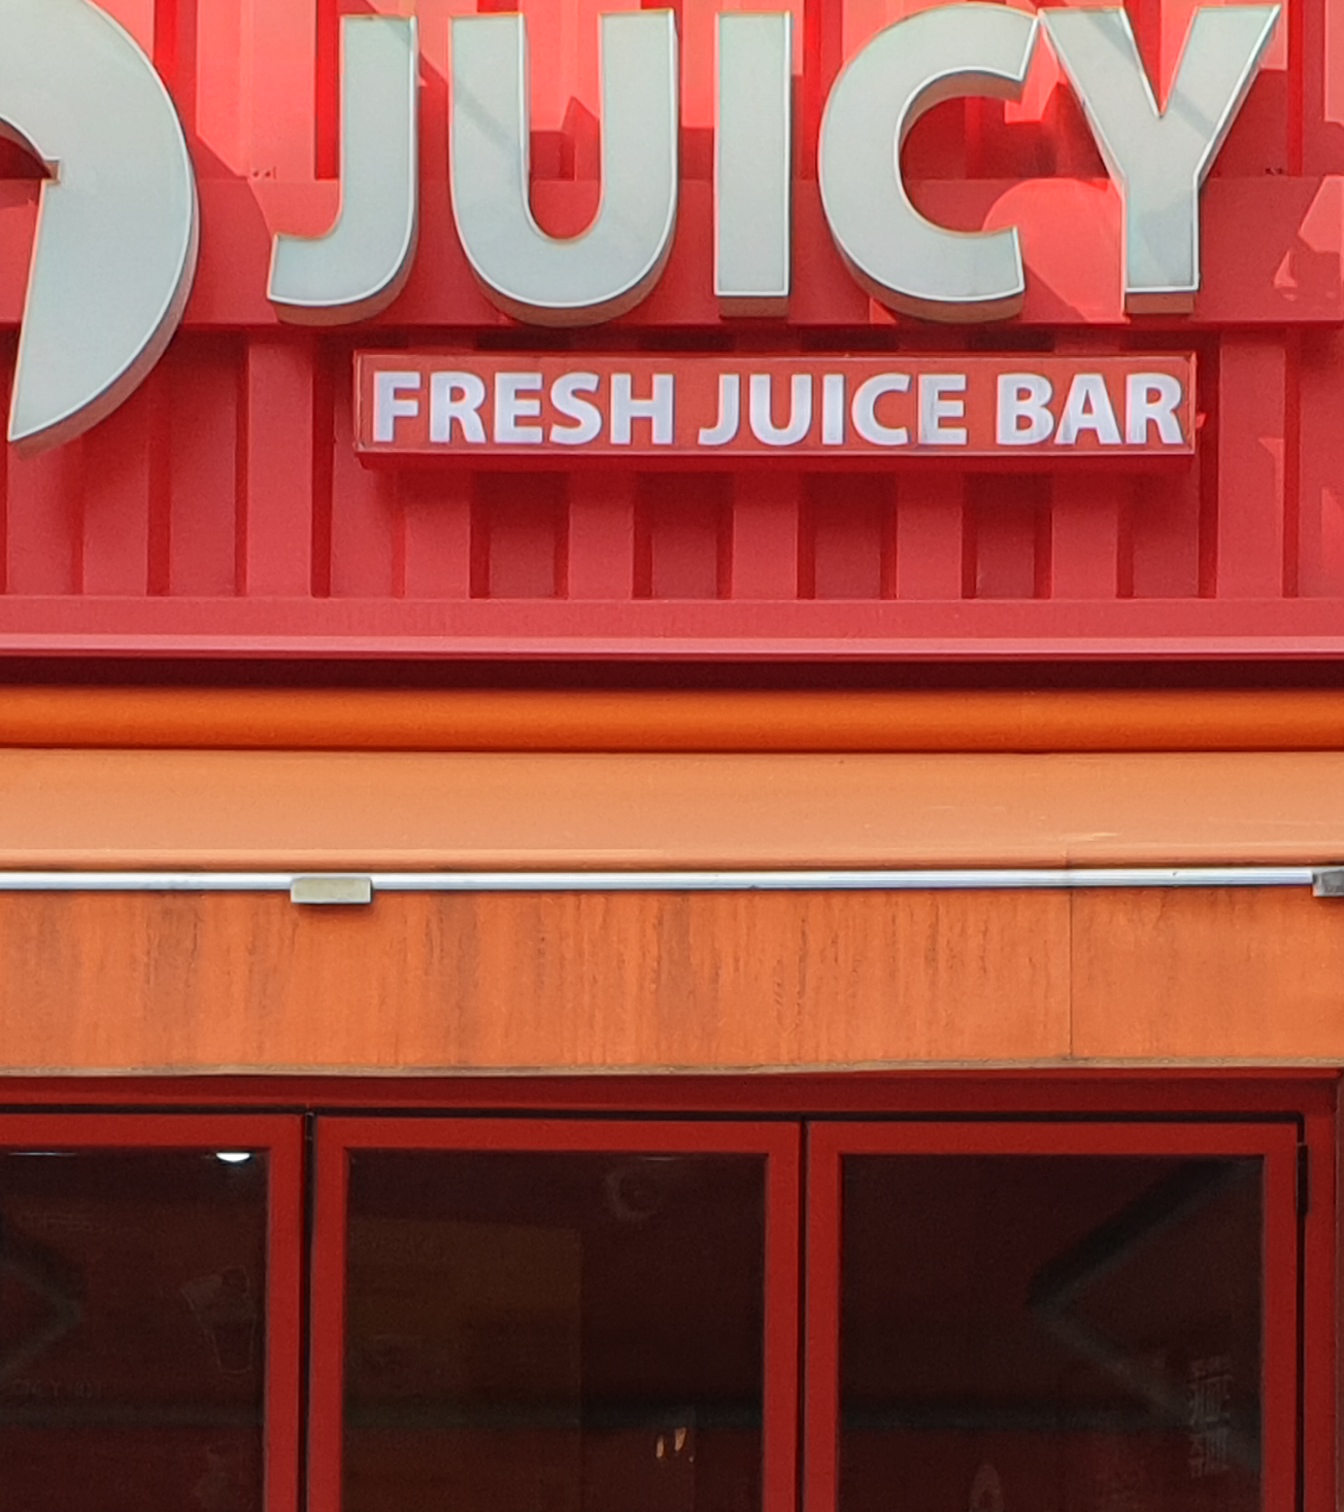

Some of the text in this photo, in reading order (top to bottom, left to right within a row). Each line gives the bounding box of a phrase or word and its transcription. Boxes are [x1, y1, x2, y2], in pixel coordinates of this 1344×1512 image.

[268, 4, 1280, 322] JUICY
[371, 370, 1186, 446] FRESH JUICE BAR
